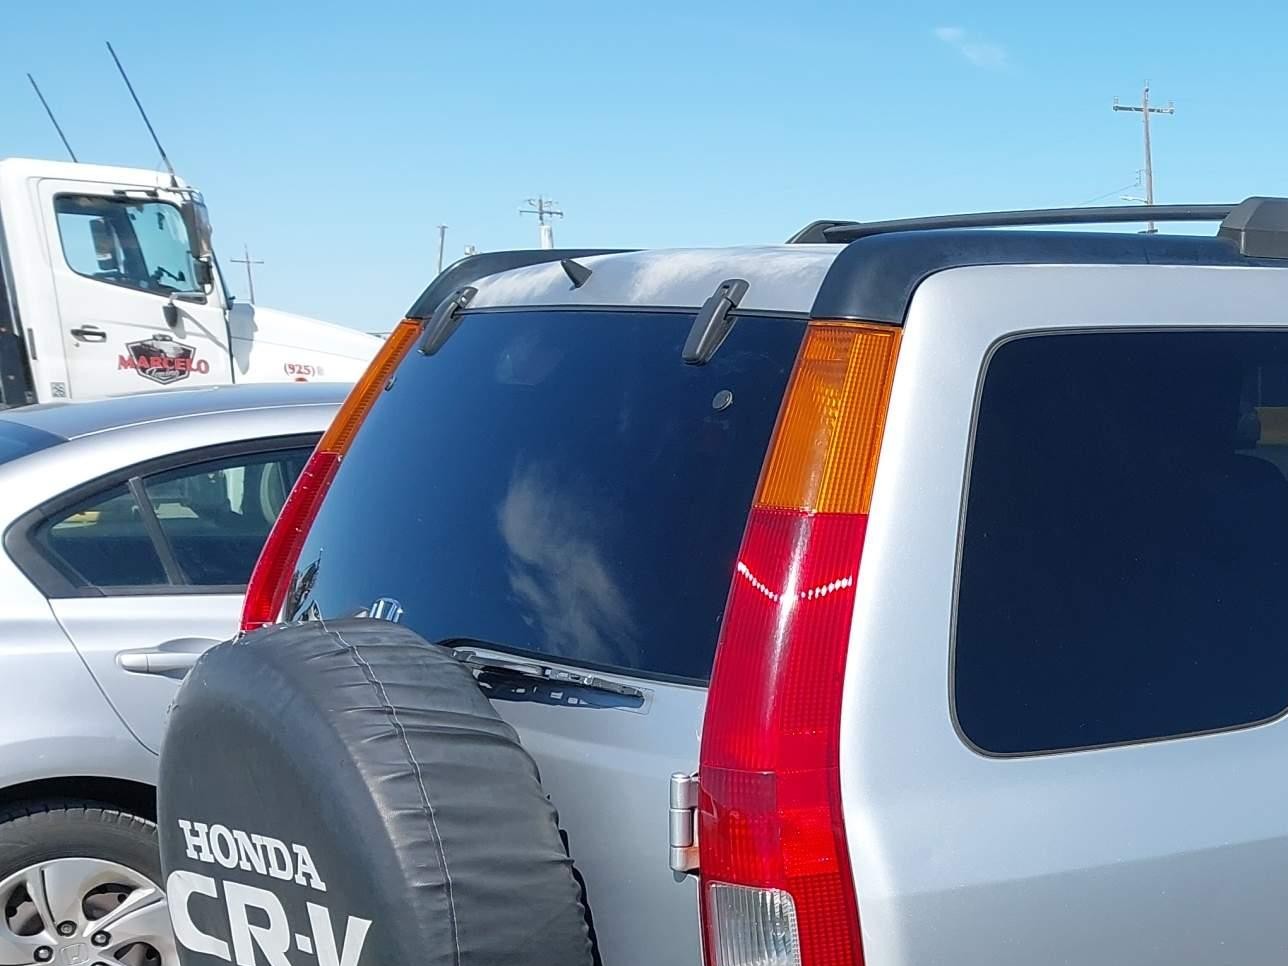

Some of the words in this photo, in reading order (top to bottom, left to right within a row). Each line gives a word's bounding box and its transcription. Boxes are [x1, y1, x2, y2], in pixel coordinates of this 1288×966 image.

[118, 354, 210, 375] MARCELO
[283, 362, 315, 377] (925)
[178, 819, 327, 892] HONDA
